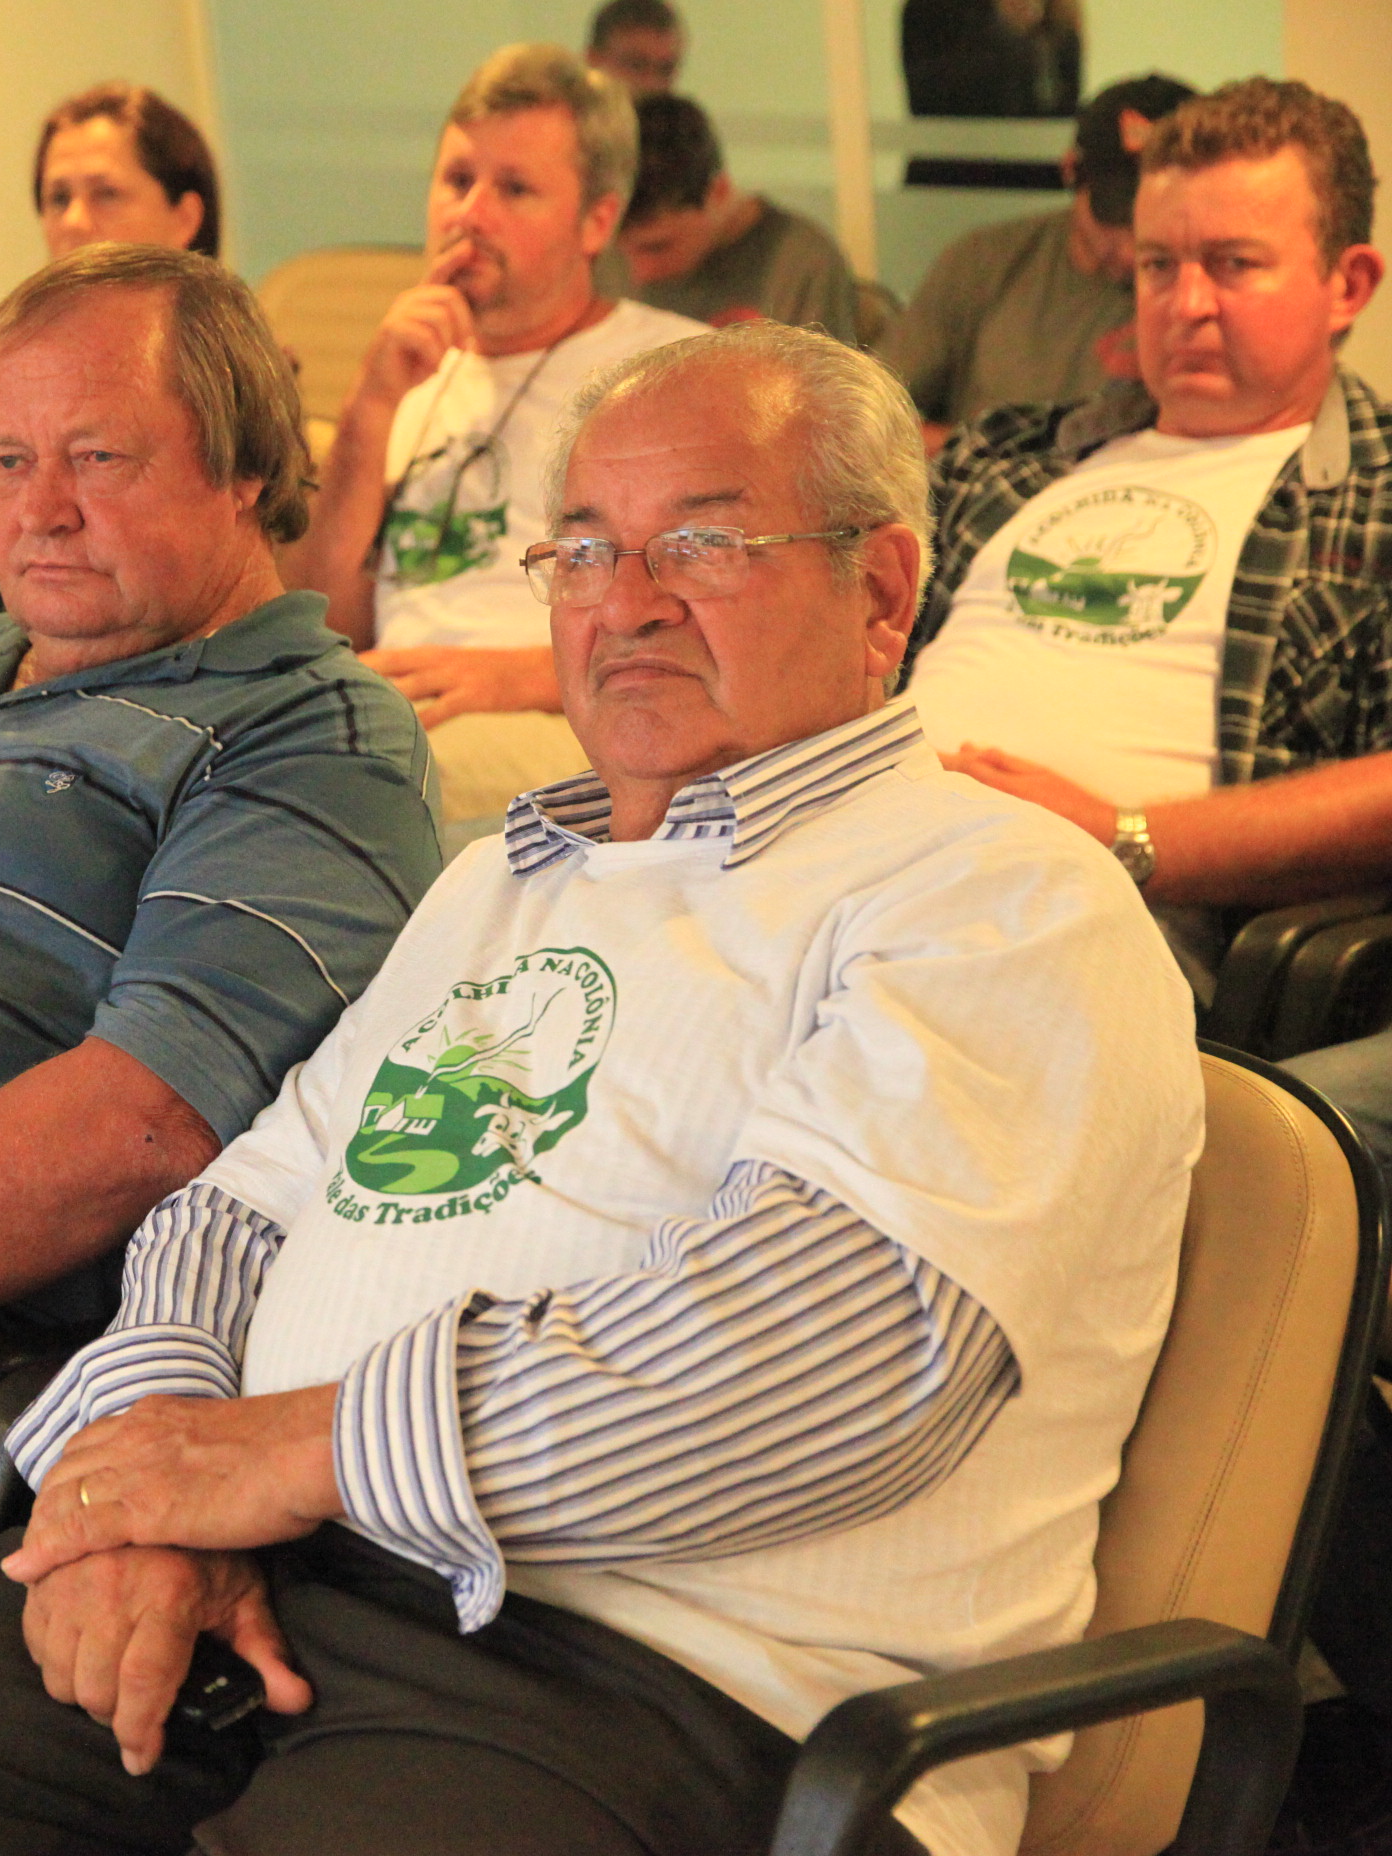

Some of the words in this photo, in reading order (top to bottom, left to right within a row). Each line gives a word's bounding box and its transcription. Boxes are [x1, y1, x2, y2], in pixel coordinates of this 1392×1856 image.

[400, 957, 529, 1053] ACLHIA
[538, 957, 574, 976] NA
[333, 1194, 370, 1223] das
